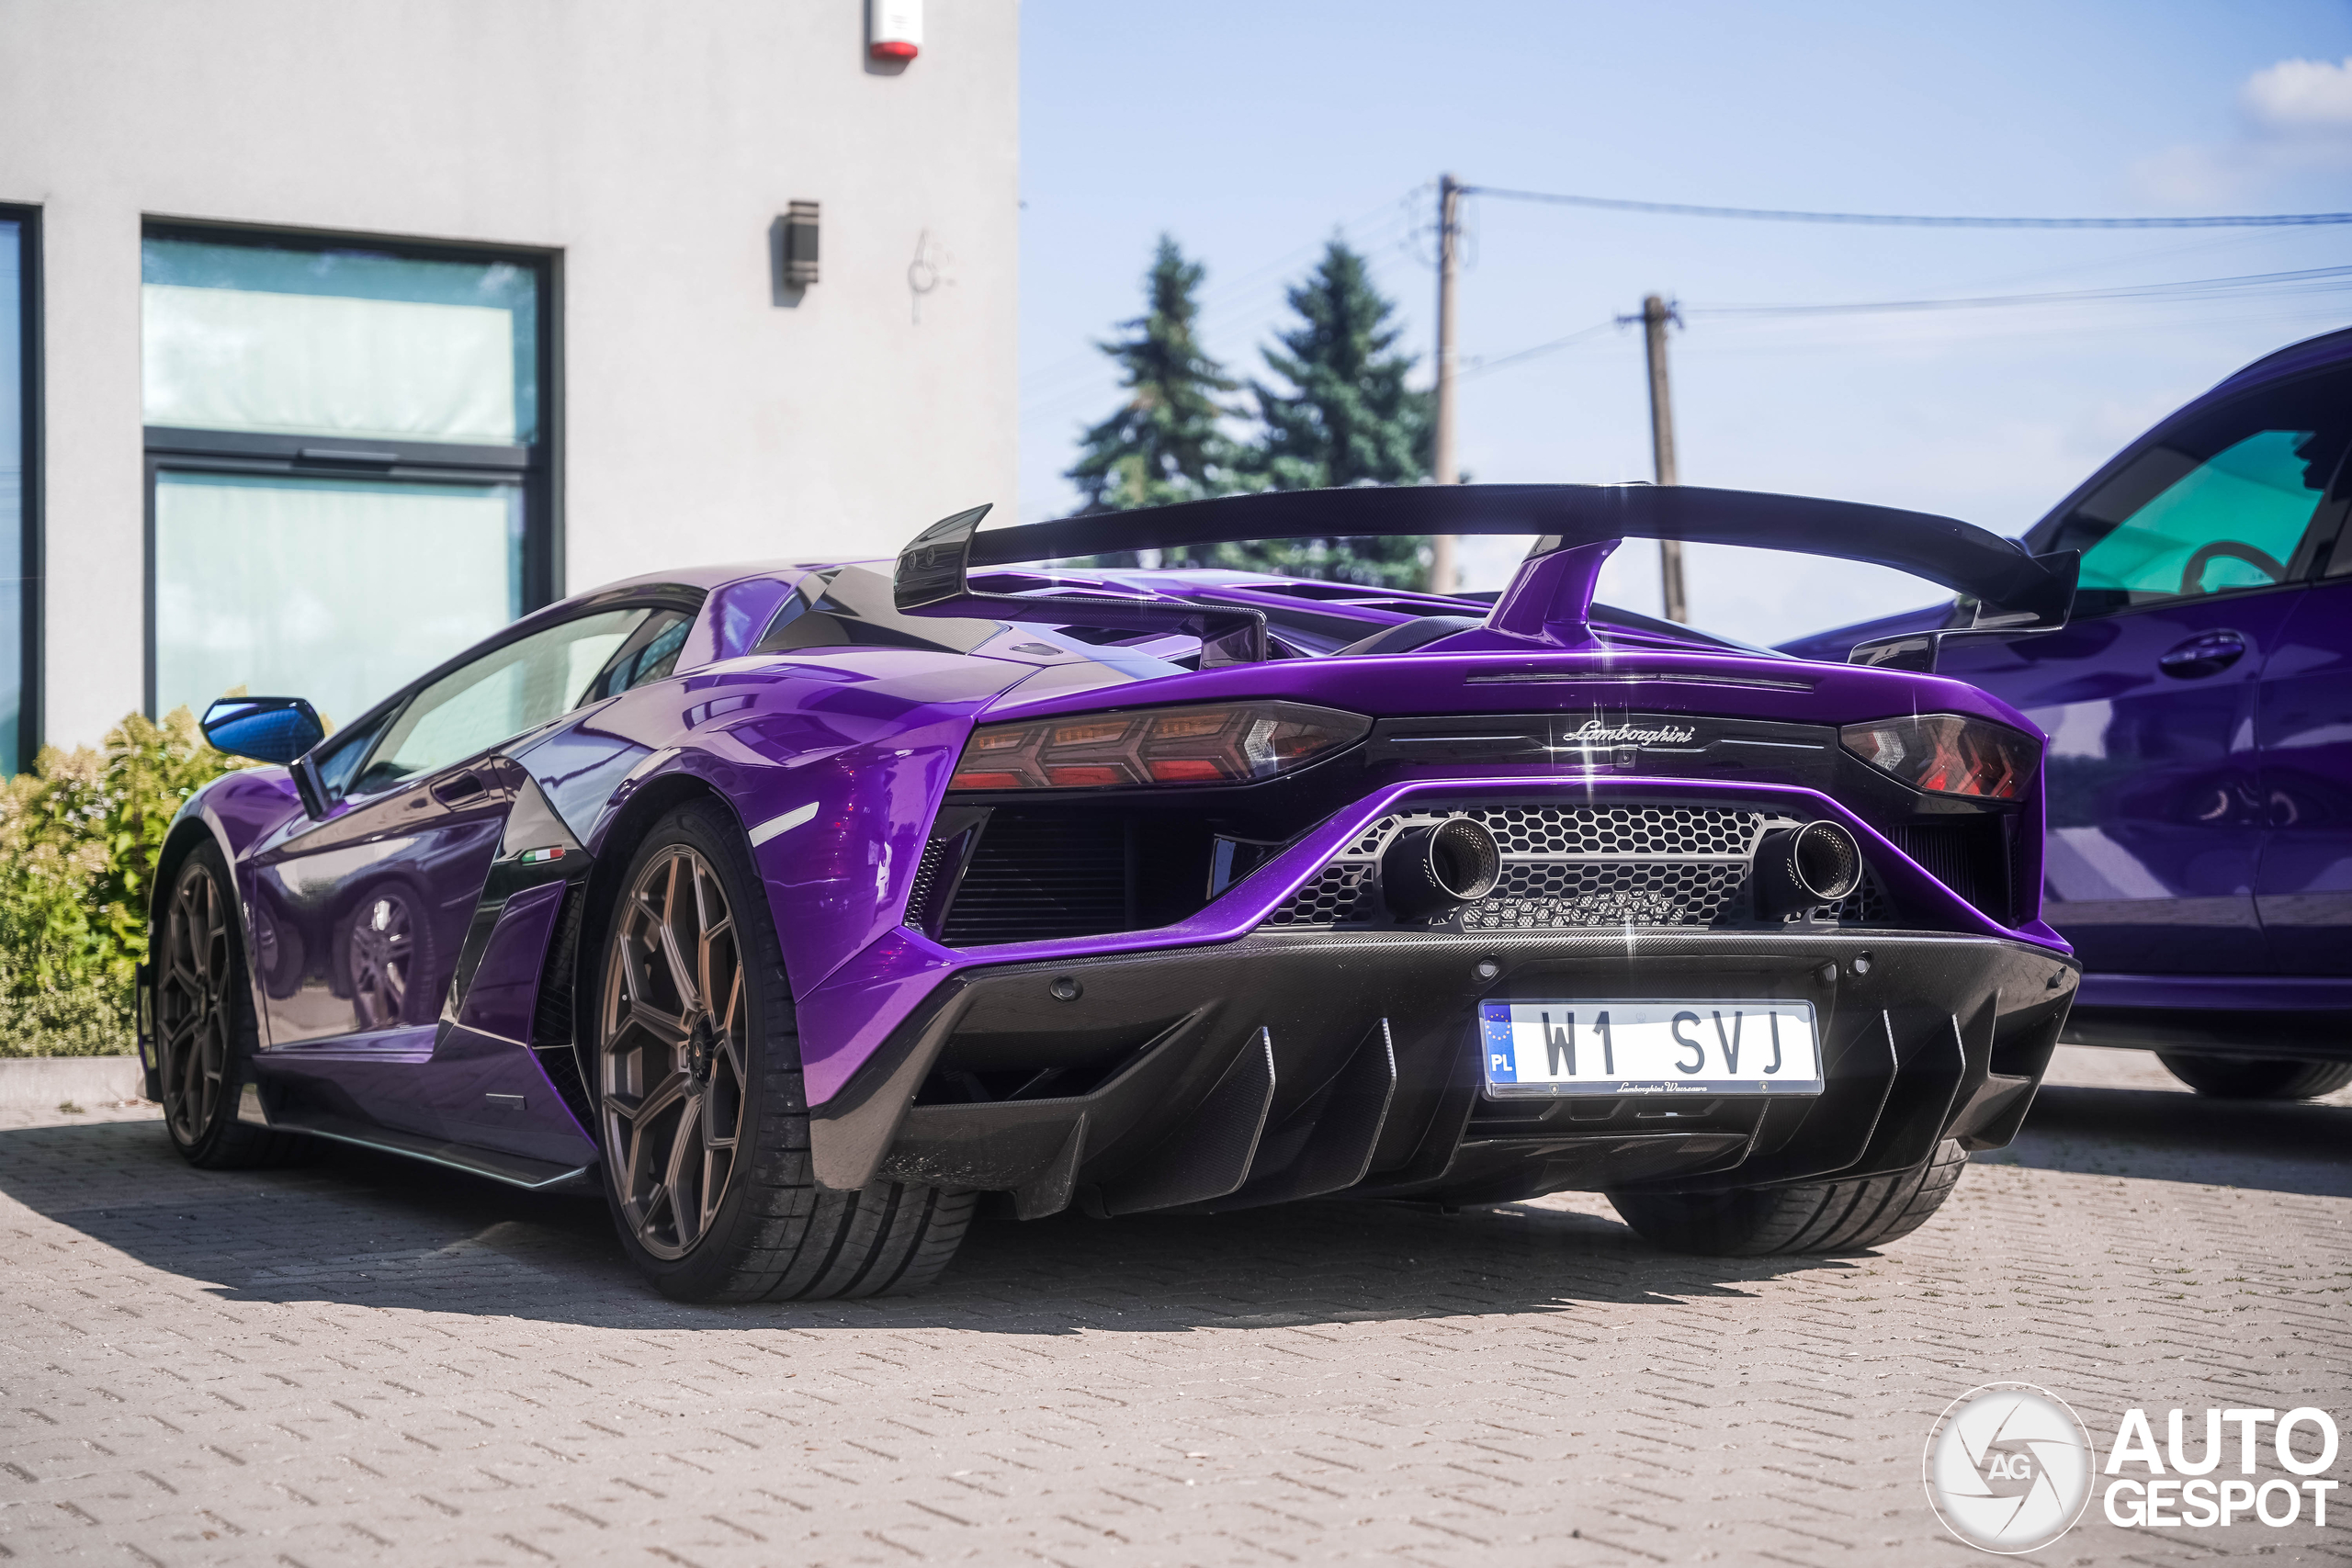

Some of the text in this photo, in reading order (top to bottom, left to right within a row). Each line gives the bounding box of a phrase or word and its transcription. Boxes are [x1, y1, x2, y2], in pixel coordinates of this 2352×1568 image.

[1563, 719, 1696, 746] Lamborghini
[1541, 1010, 1782, 1077] W1 SVJ
[1490, 1054, 1513, 1072] PL
[1616, 1081, 1708, 1095] Lamborghini Warszawa
